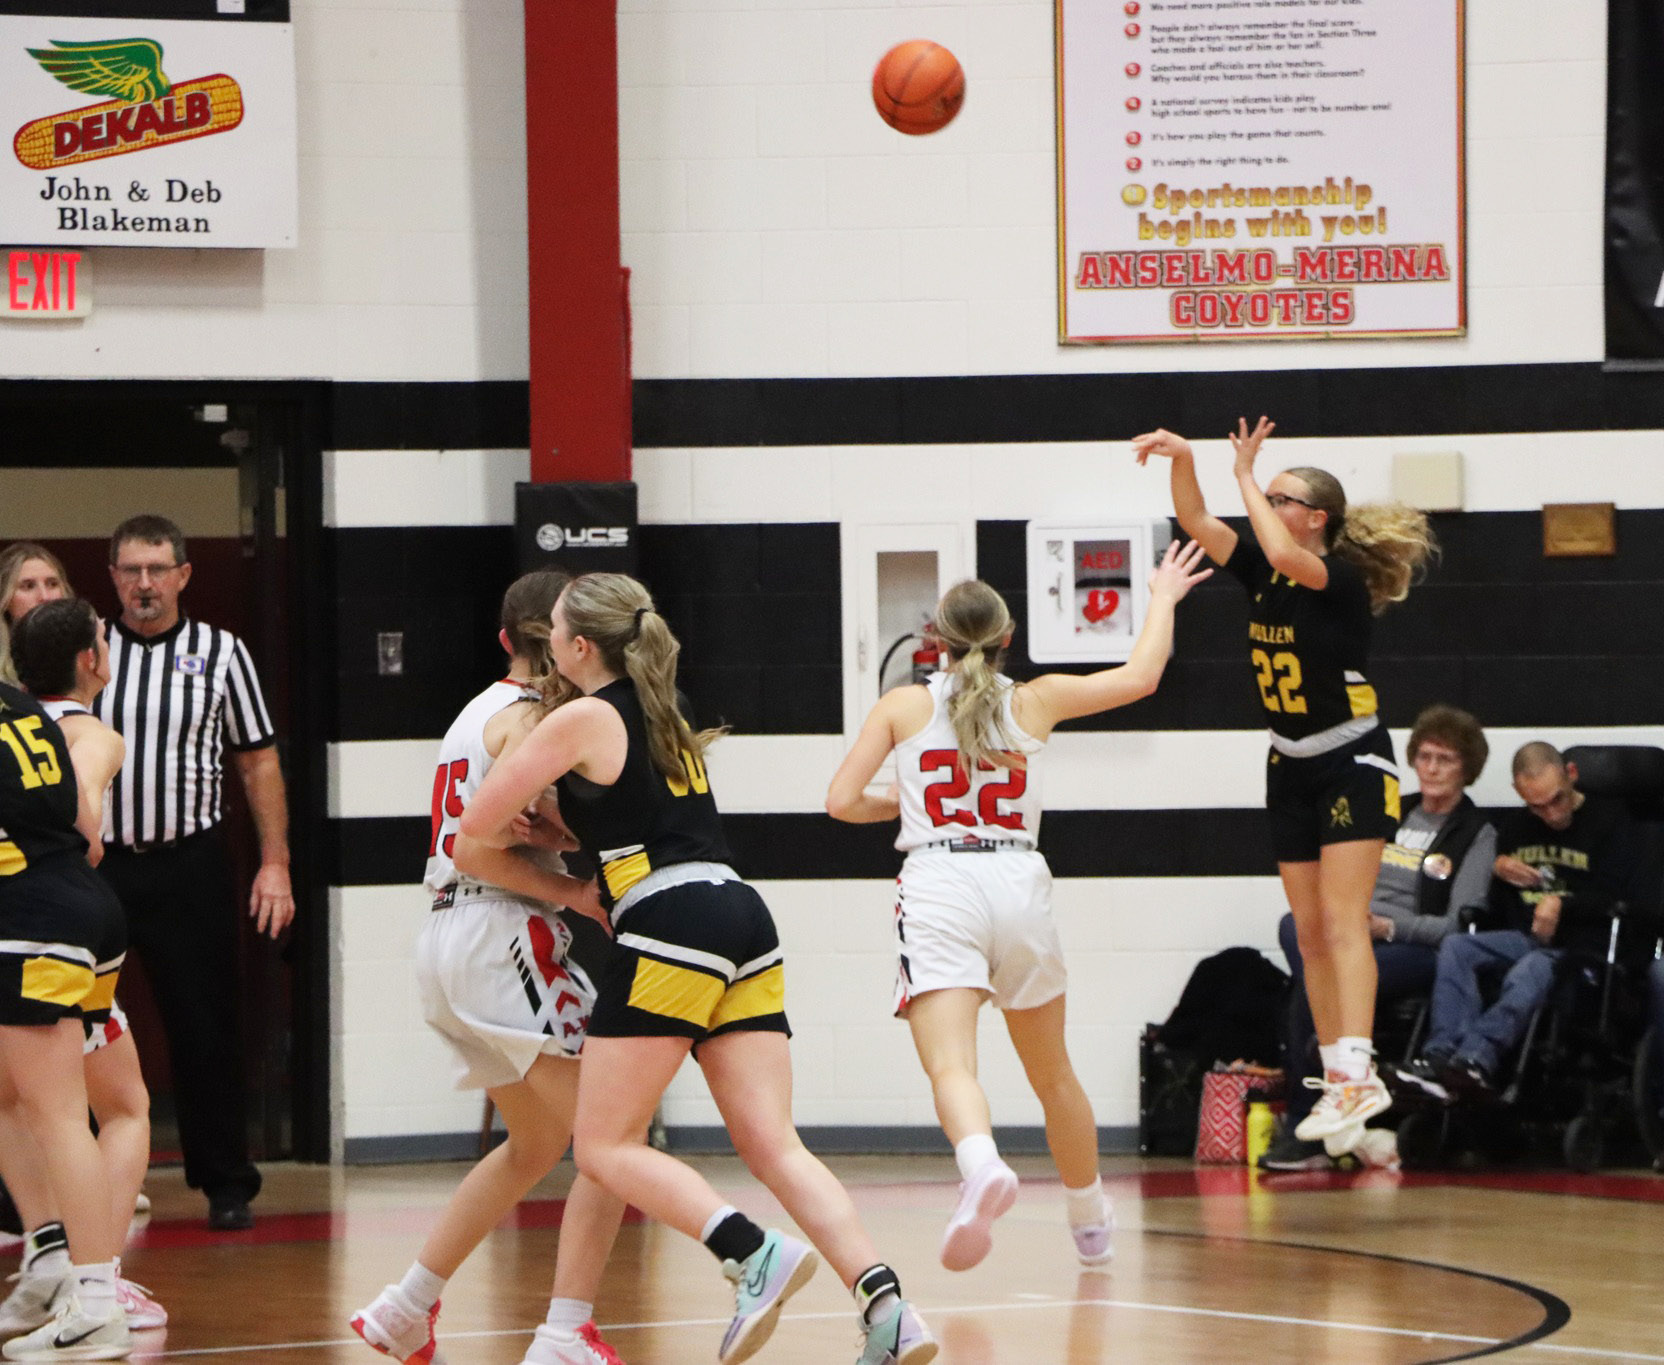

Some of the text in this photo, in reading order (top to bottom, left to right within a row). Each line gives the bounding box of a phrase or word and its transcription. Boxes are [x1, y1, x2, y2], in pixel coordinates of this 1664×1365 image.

[54, 91, 213, 160] DEKALB
[41, 176, 222, 203] John & Deb
[1151, 177, 1373, 216] Sportsmanship
[57, 207, 211, 233] Blakeman
[1138, 206, 1388, 246] begins with you!
[8, 252, 81, 311] EXIT
[1076, 244, 1451, 289] ANSELMO-MERNA
[1169, 288, 1355, 328] COYOTES
[564, 526, 629, 543] UCS
[1081, 550, 1124, 570] AED
[1251, 648, 1308, 714] 22
[0, 714, 62, 790] 15
[919, 748, 1028, 831] 22
